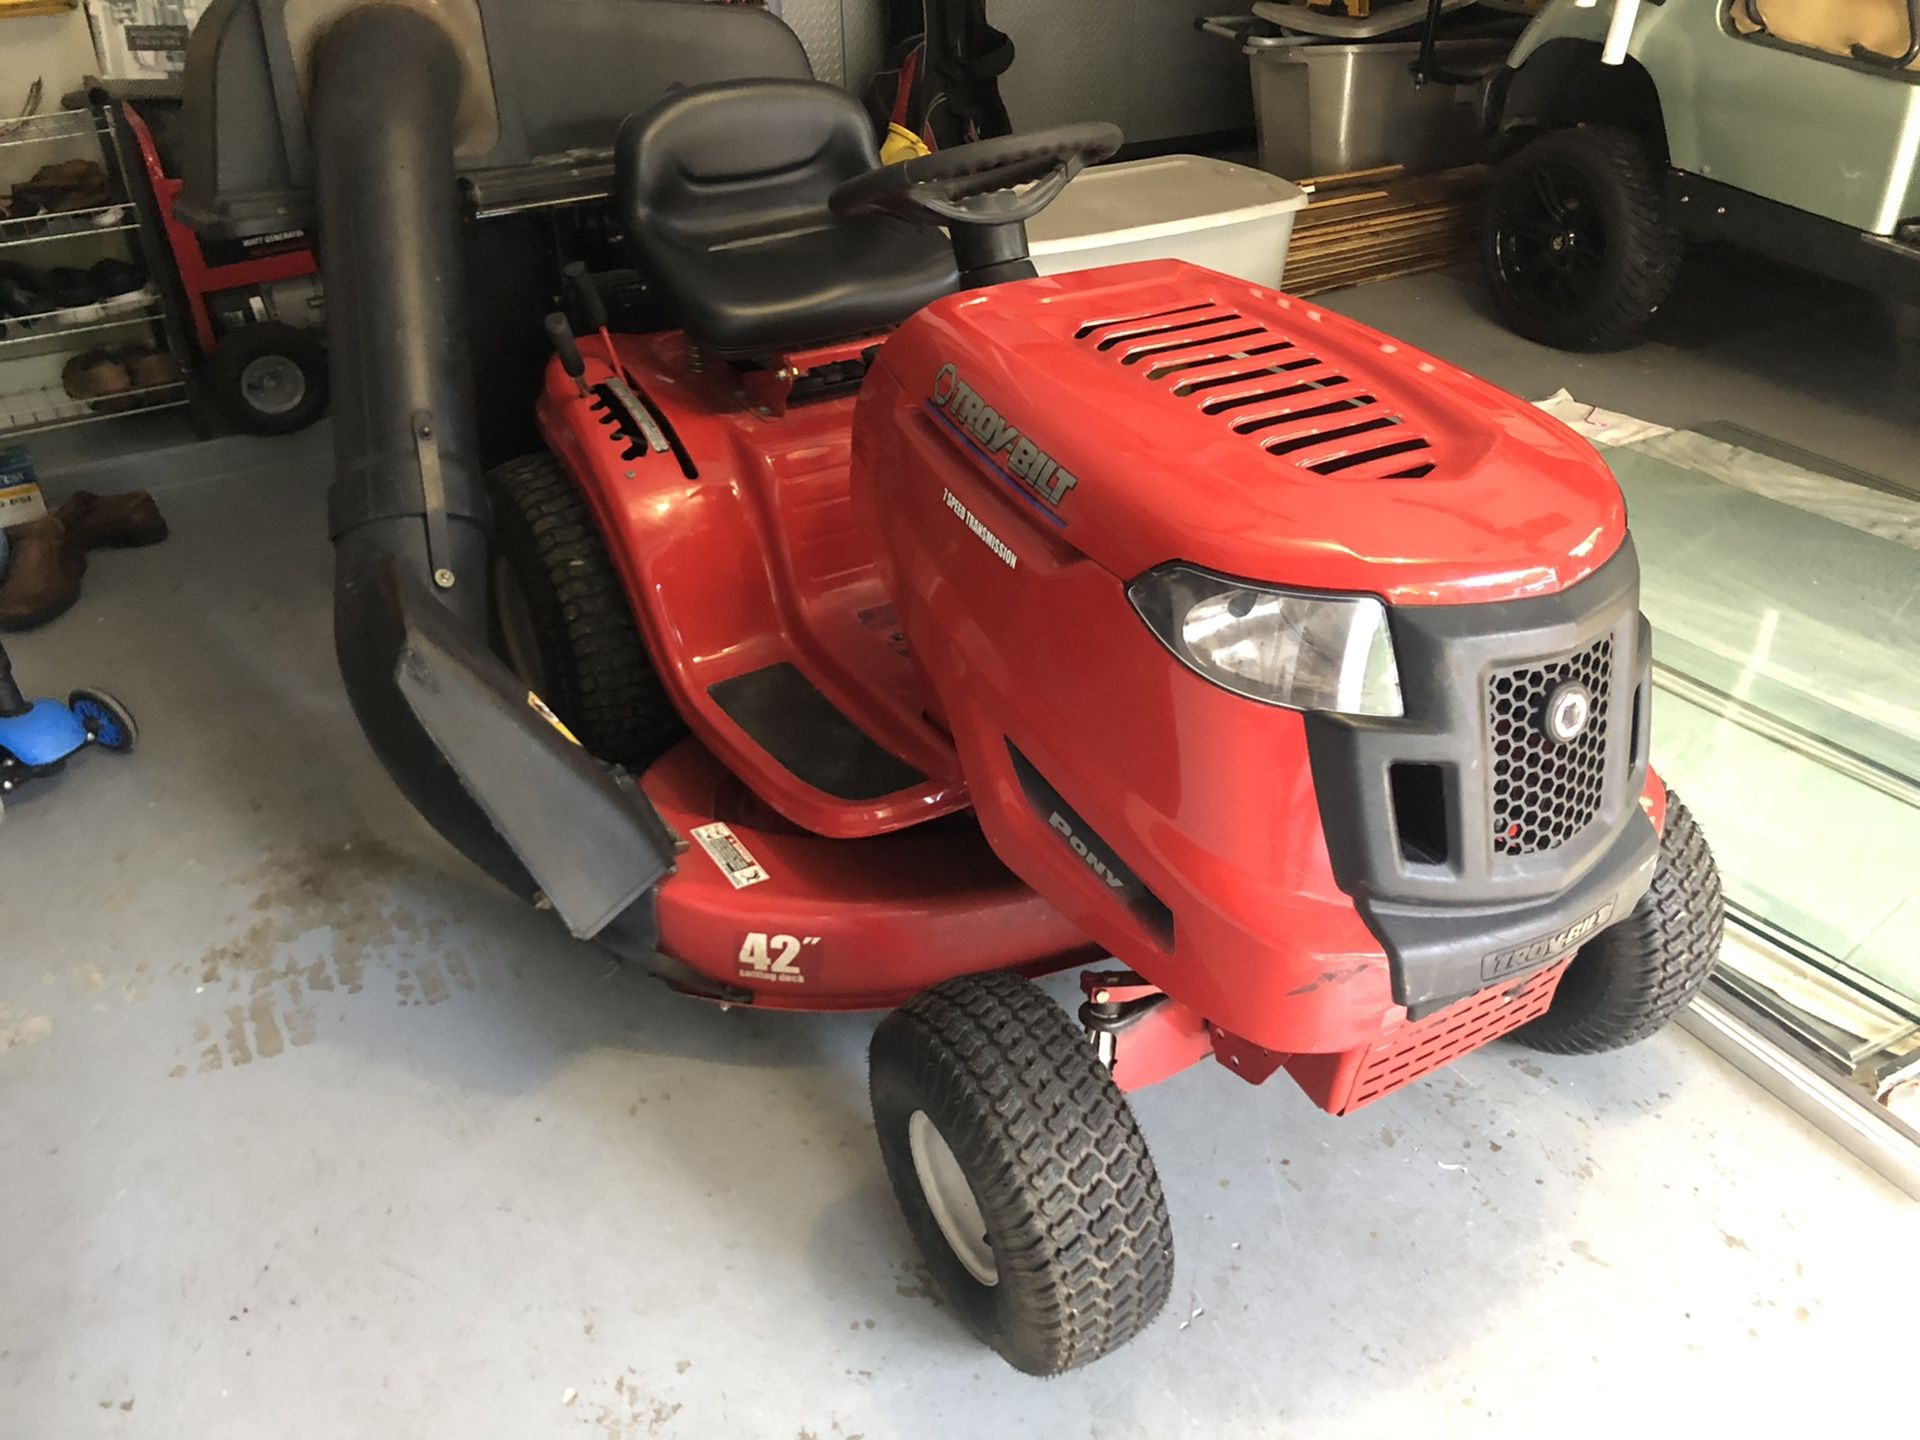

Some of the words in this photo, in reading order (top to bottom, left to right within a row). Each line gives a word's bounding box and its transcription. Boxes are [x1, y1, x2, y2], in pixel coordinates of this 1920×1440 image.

[951, 380, 1078, 506] TROY-BILT
[942, 487, 949, 502] 7
[946, 491, 967, 521] SPEED
[965, 510, 1018, 570] TRANSMISSION
[1048, 811, 1124, 887] PONY
